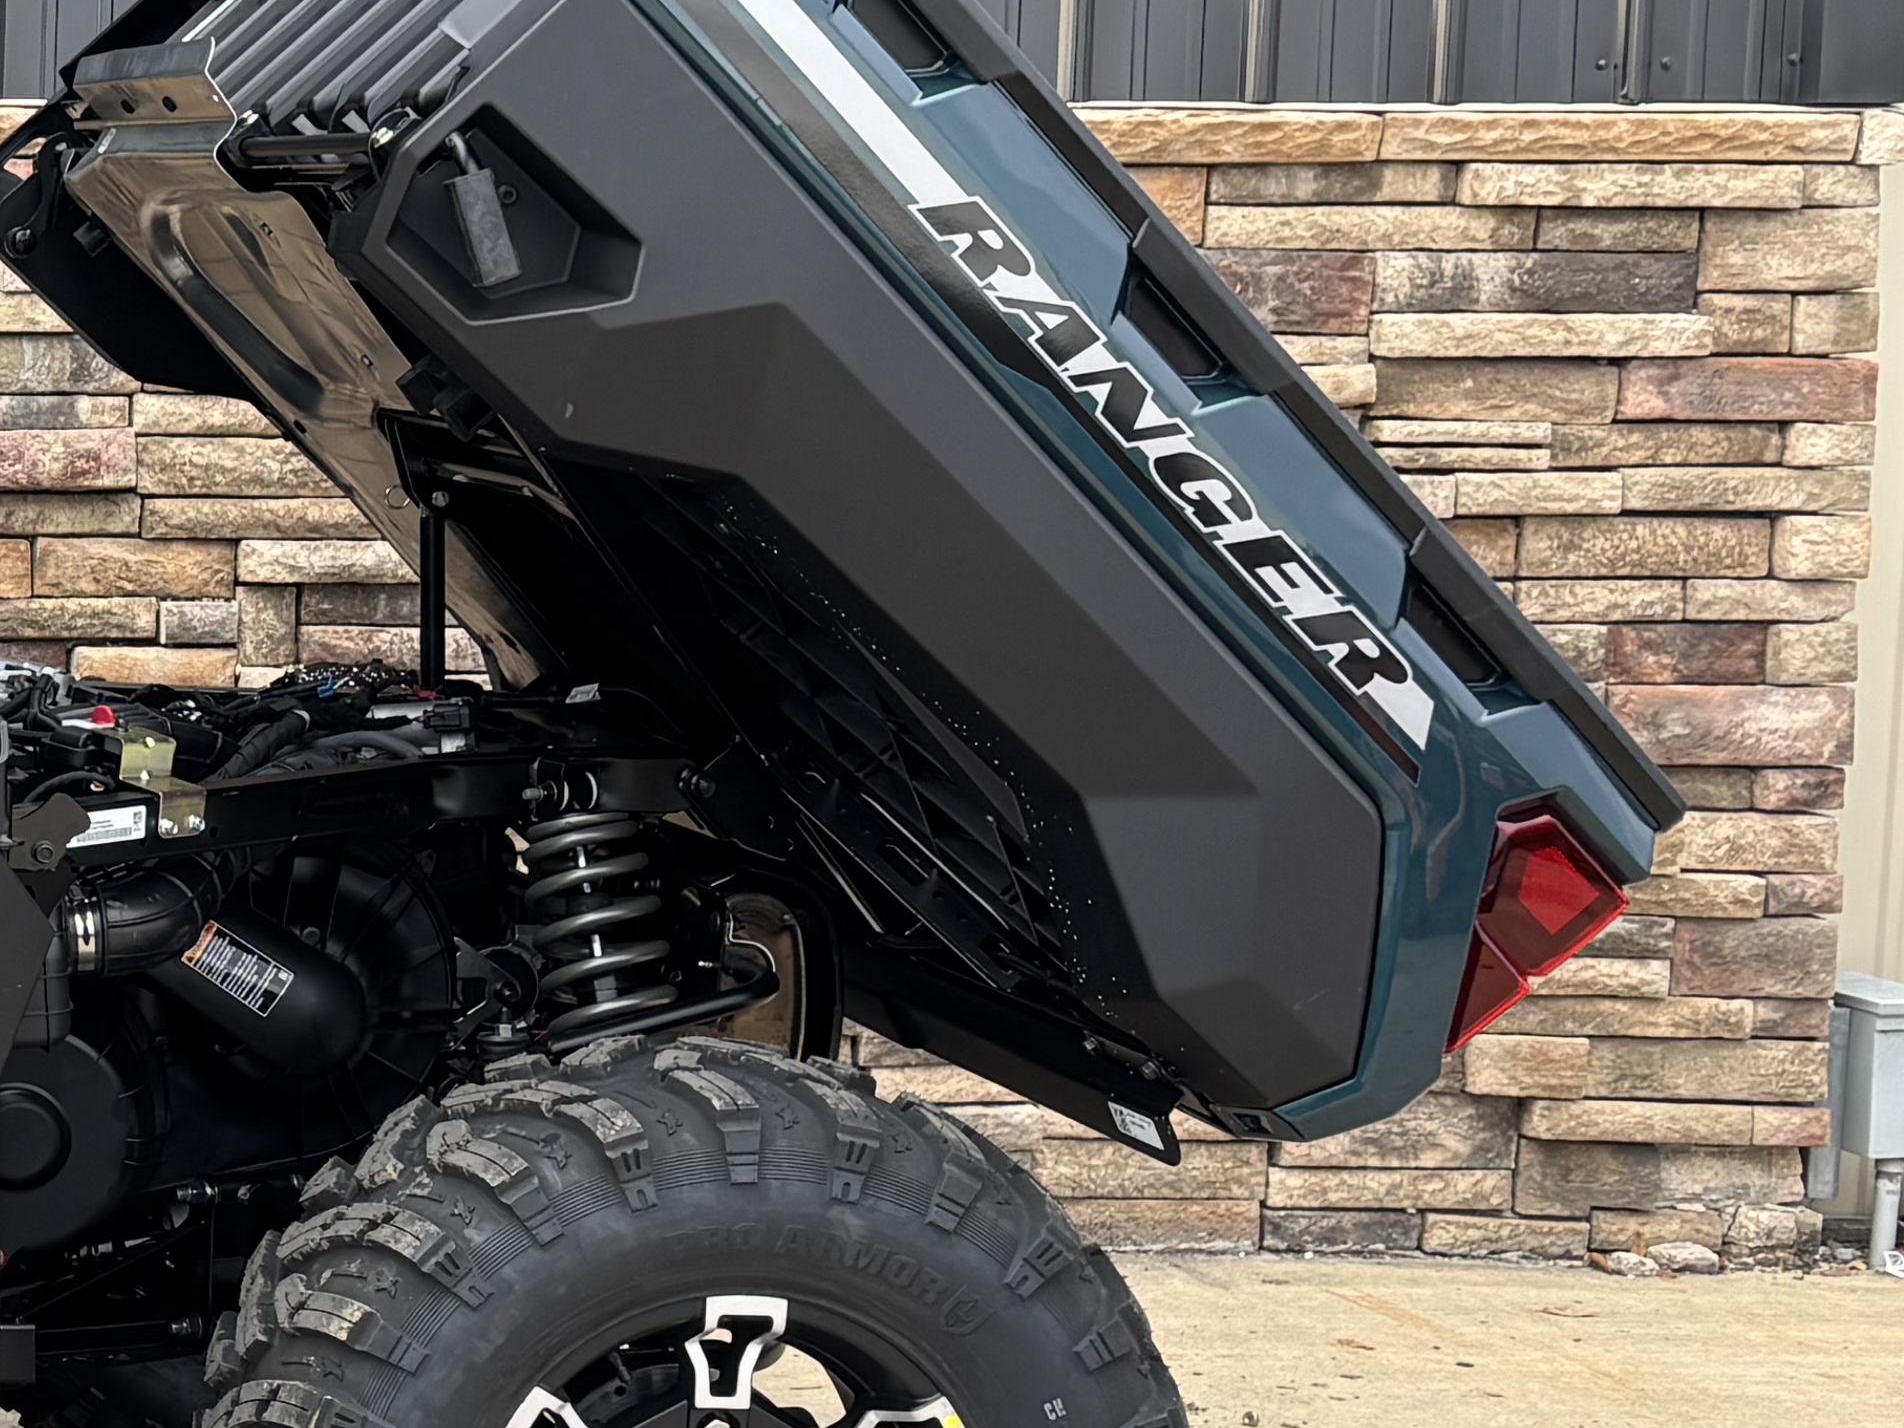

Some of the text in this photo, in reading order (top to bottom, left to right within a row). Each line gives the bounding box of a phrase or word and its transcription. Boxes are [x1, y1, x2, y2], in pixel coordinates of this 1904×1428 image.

[908, 195, 1413, 696] RANGER
[664, 1222, 946, 1308] PRO ARMOR
